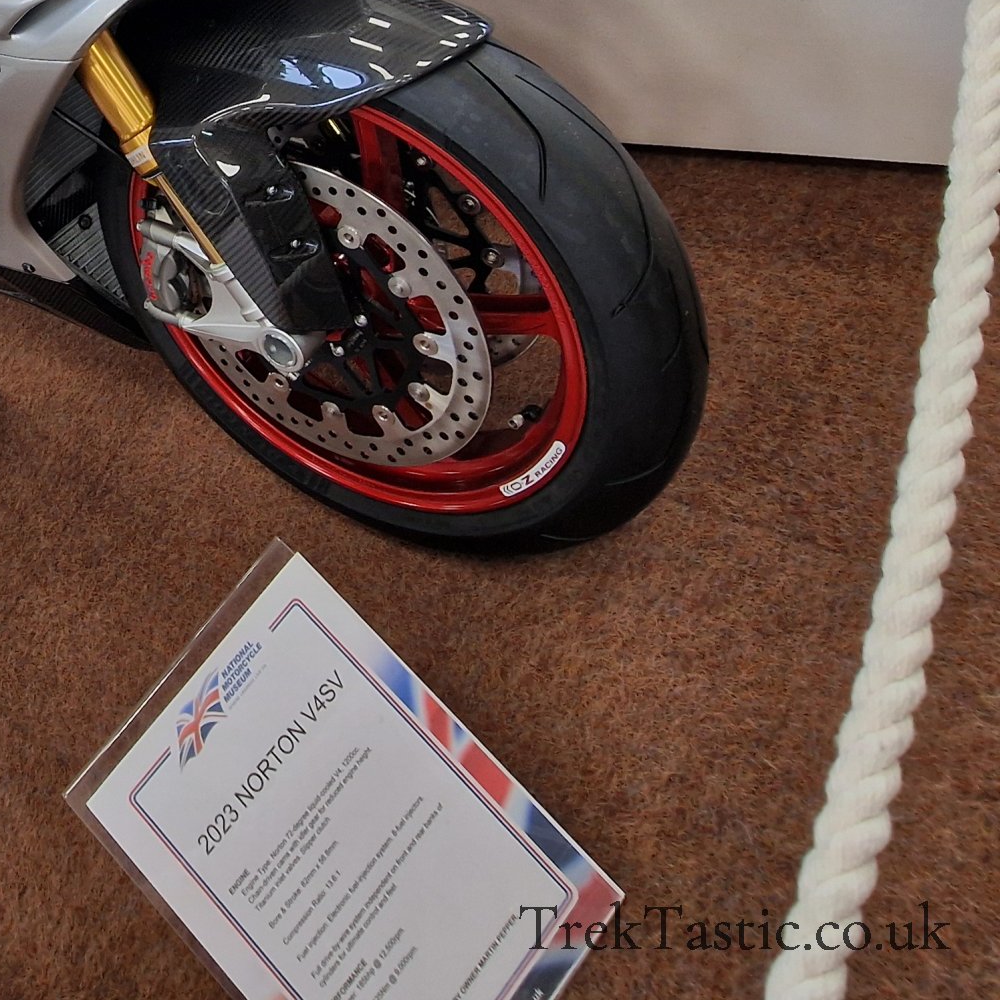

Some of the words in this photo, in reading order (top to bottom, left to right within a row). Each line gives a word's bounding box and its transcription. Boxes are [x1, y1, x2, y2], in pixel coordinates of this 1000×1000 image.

[534, 447, 563, 478] RACING
[221, 641, 254, 679] NATIONAL
[221, 642, 262, 692] MOTORCYCLE
[223, 668, 252, 703] MUSEUM
[195, 800, 240, 856] 2023
[233, 719, 306, 809] NORTON
[299, 668, 347, 726] V4SV
[287, 838, 300, 853] with
[307, 813, 321, 830] gear
[323, 781, 344, 807] reduced
[341, 763, 359, 786] engine
[269, 837, 287, 860] Norton
[228, 868, 250, 895] ENGINE
[254, 884, 276, 912] Titanium
[310, 964, 322, 979] Full
[347, 906, 367, 931] system
[363, 870, 393, 910] independent
[395, 849, 408, 866] front
[405, 837, 417, 852] and
[422, 808, 438, 829] banks
[268, 911, 282, 929] Bore
[282, 904, 315, 947] Compression
[296, 945, 309, 962] Fuel
[325, 890, 351, 923] Electronic
[344, 925, 365, 953] ultimate
[361, 905, 380, 929] control
[376, 893, 389, 909] and
[458, 965, 481, 995] OWNER
[477, 939, 499, 969] MARTIN
[495, 913, 517, 943] PEPPER
